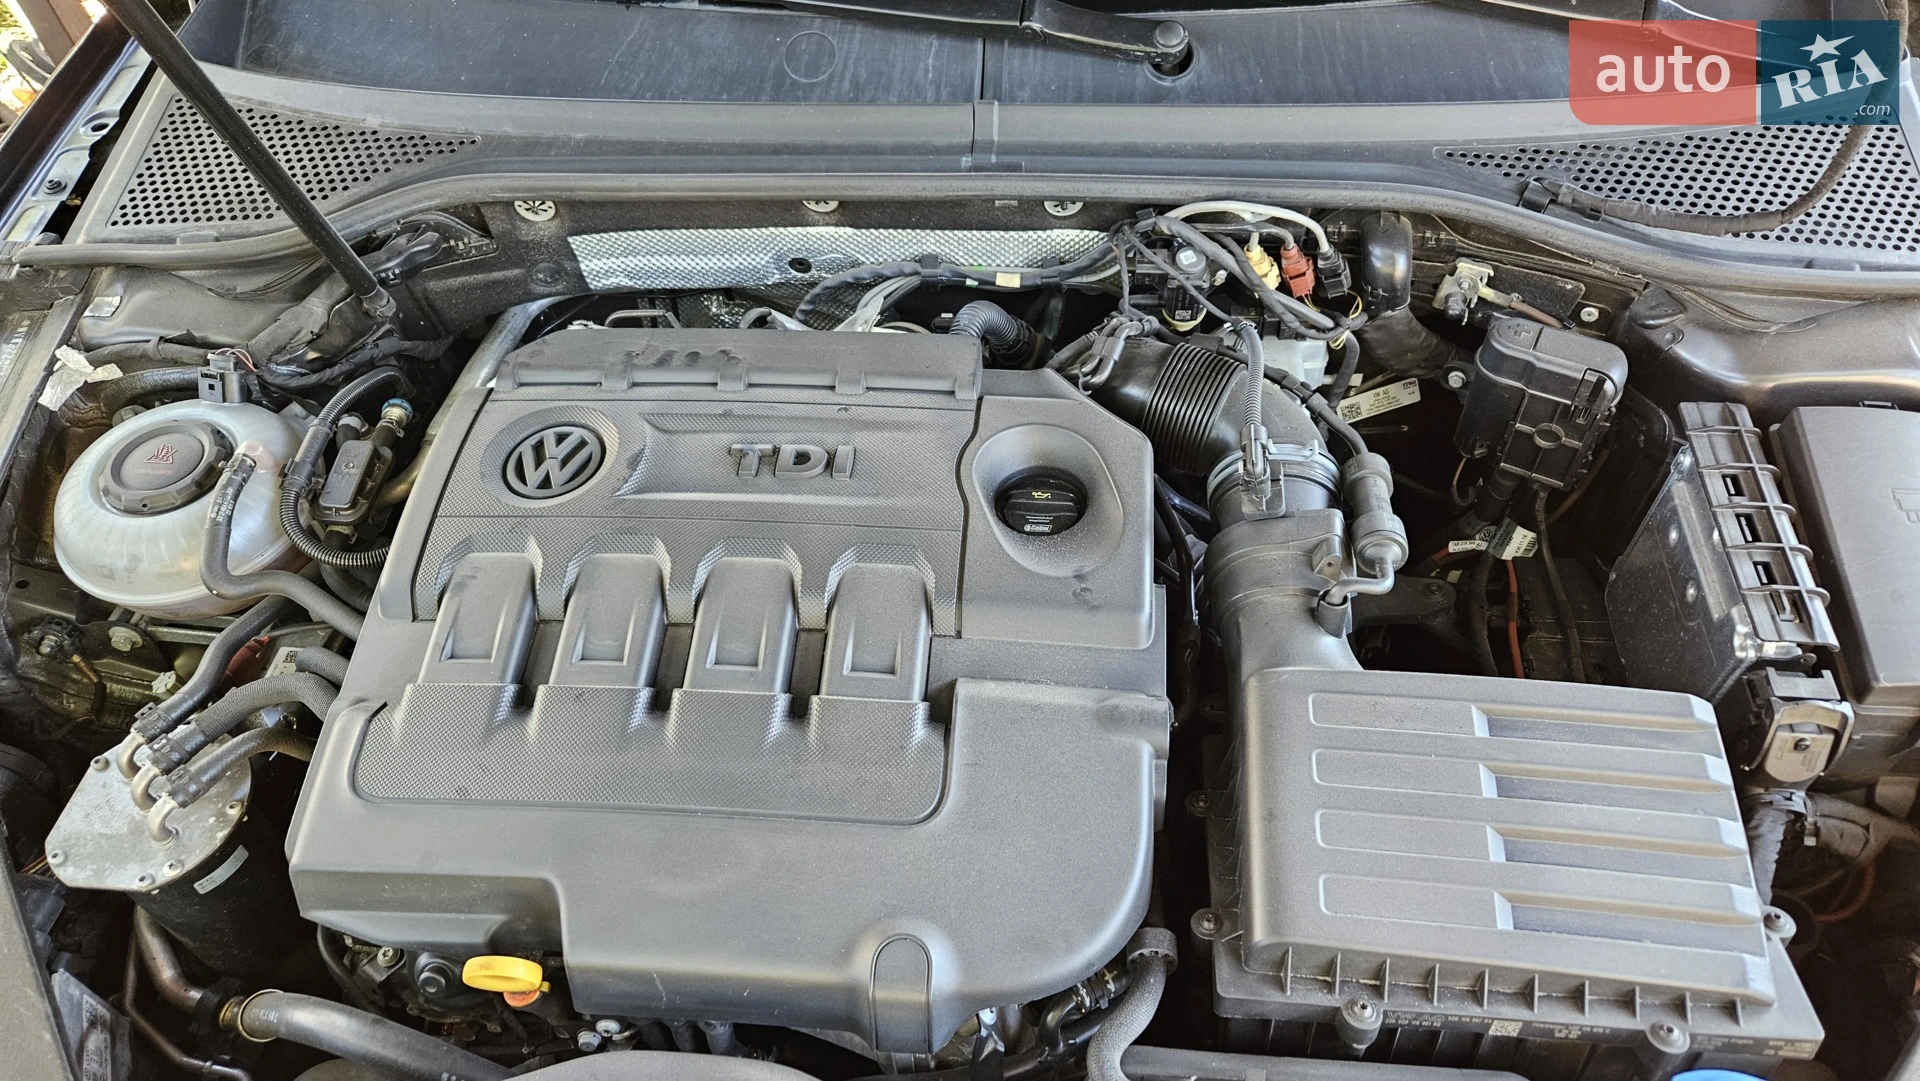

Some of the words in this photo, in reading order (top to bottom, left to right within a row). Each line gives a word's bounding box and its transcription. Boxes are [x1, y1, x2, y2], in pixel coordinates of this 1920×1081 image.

[506, 425, 602, 497] VW
[729, 443, 856, 480] TDI
[1387, 1011, 1416, 1020] VW
[1419, 1013, 1445, 1024] AG
